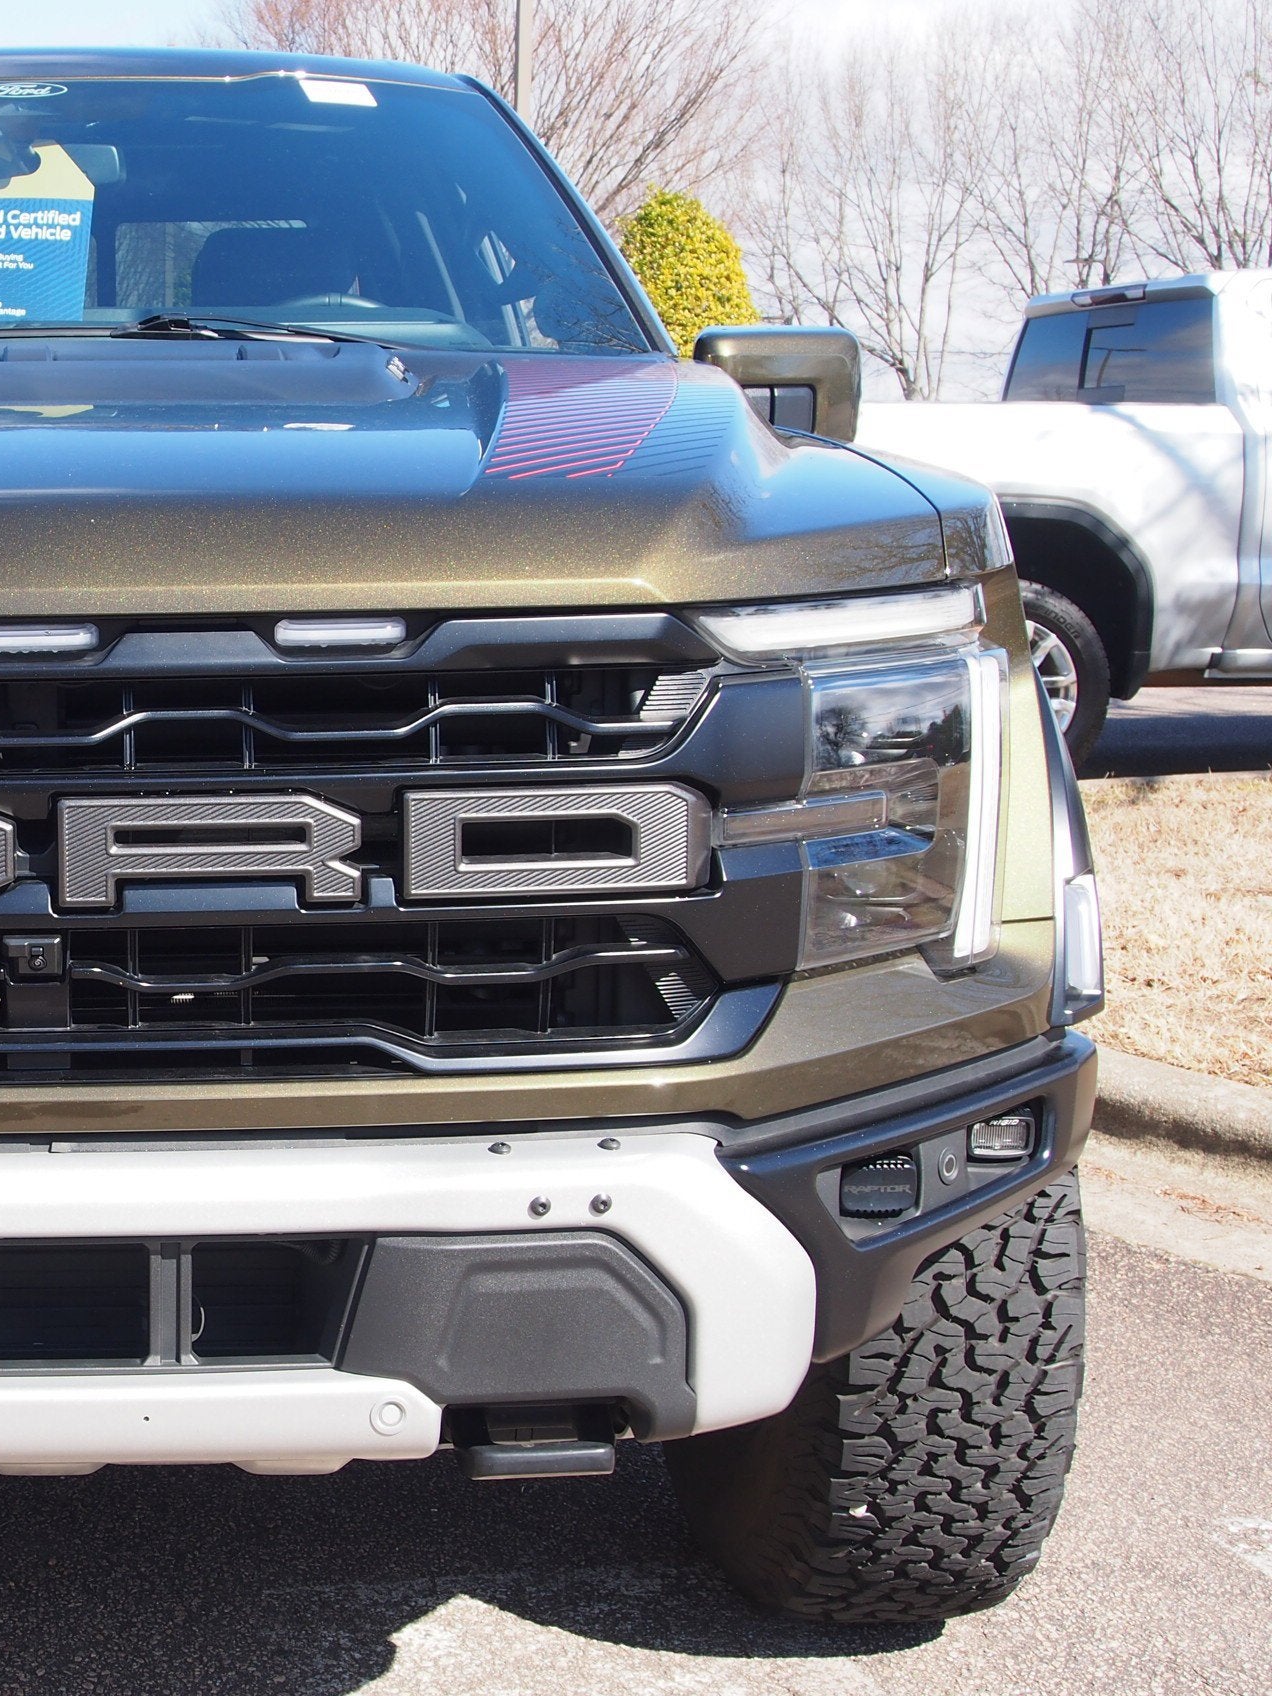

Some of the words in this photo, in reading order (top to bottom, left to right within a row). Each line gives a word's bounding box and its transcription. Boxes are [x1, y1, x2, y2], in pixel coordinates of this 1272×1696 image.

[6, 209, 81, 226] Certified
[9, 225, 72, 241] Vehicle
[18, 262, 34, 270] You
[843, 1184, 913, 1195] RAPTOR
